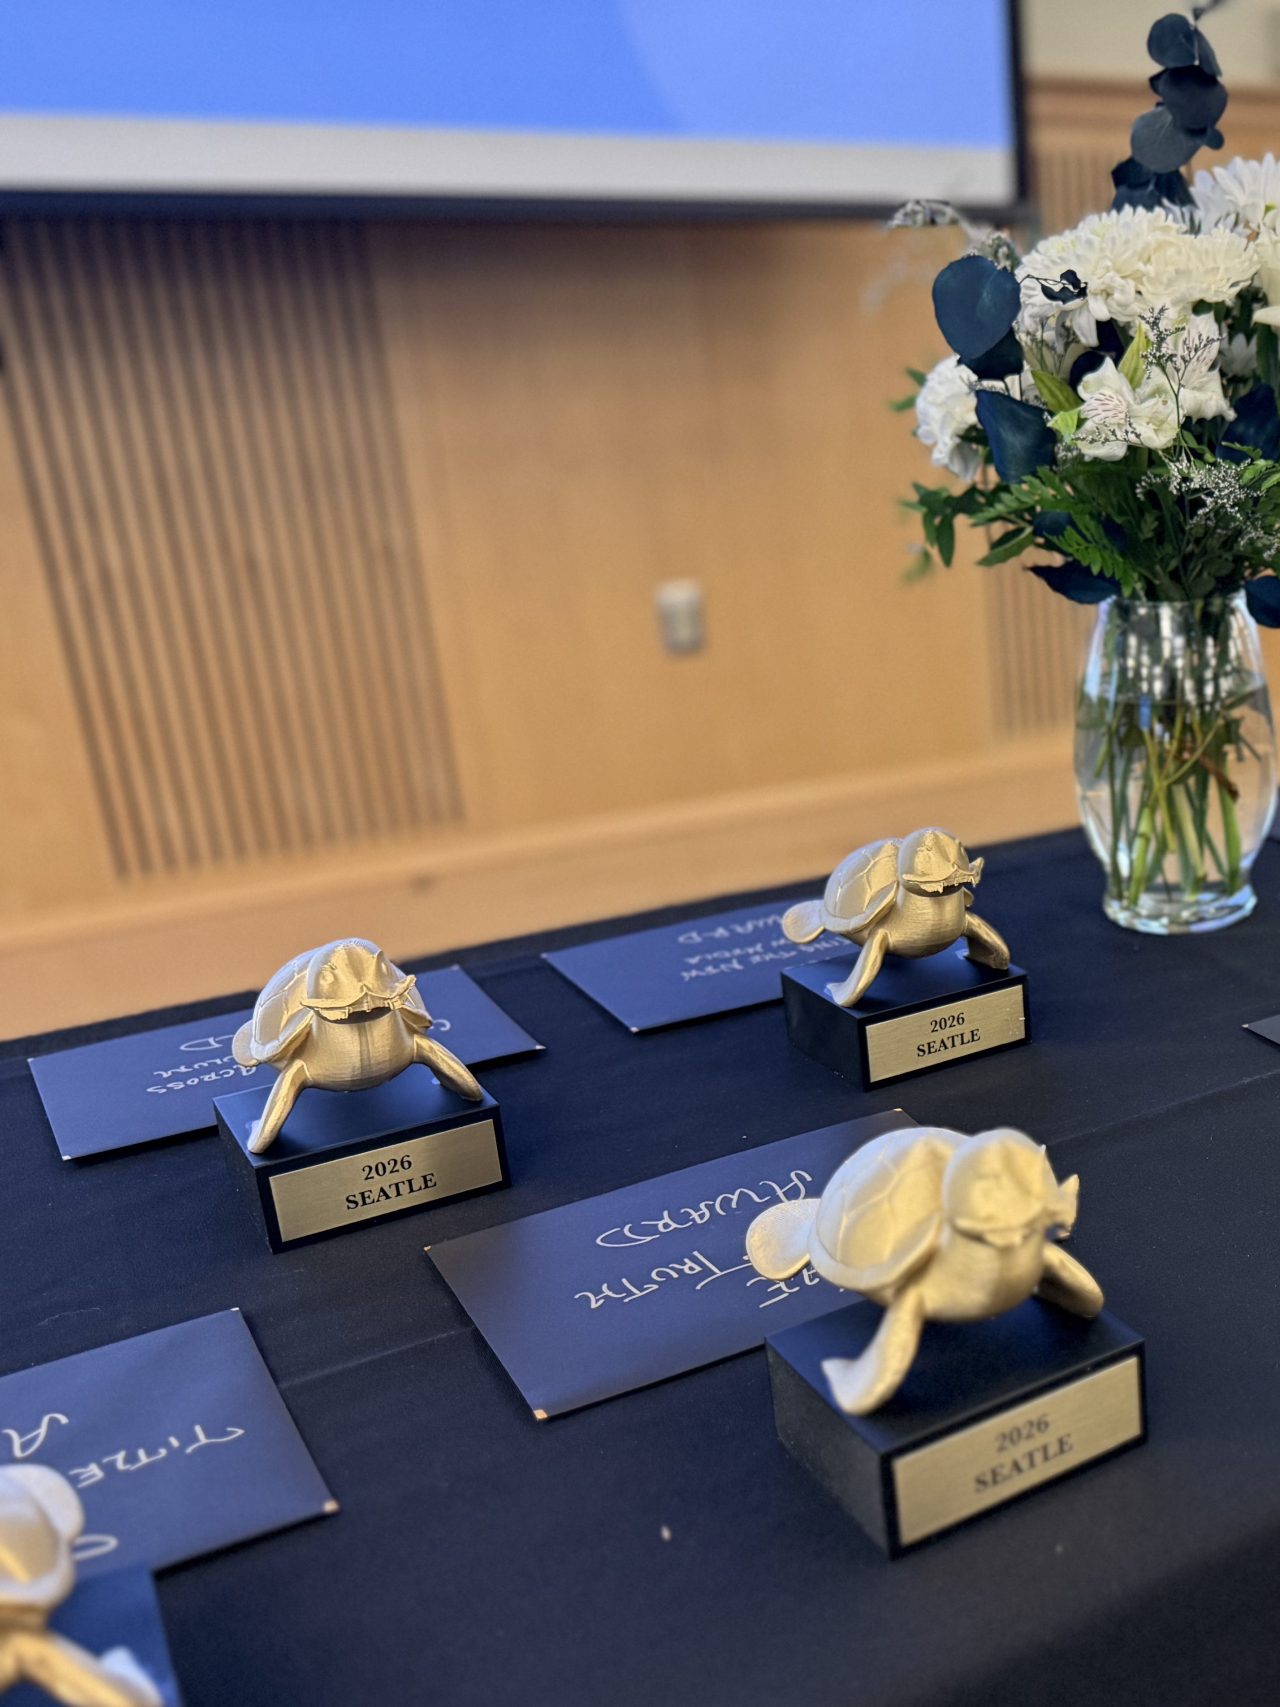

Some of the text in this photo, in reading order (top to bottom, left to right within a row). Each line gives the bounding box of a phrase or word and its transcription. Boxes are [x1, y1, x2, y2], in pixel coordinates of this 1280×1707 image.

[930, 1012, 965, 1033] 2026
[916, 1028, 981, 1057] SEATLE
[145, 1064, 257, 1094] ACROSS
[362, 1154, 412, 1180] 2026
[345, 1173, 437, 1210] SEATLE
[595, 1169, 813, 1248] AWARD
[574, 1250, 752, 1309] TRUTH
[995, 1413, 1050, 1453] 2026
[974, 1432, 1074, 1494] SEATLE
